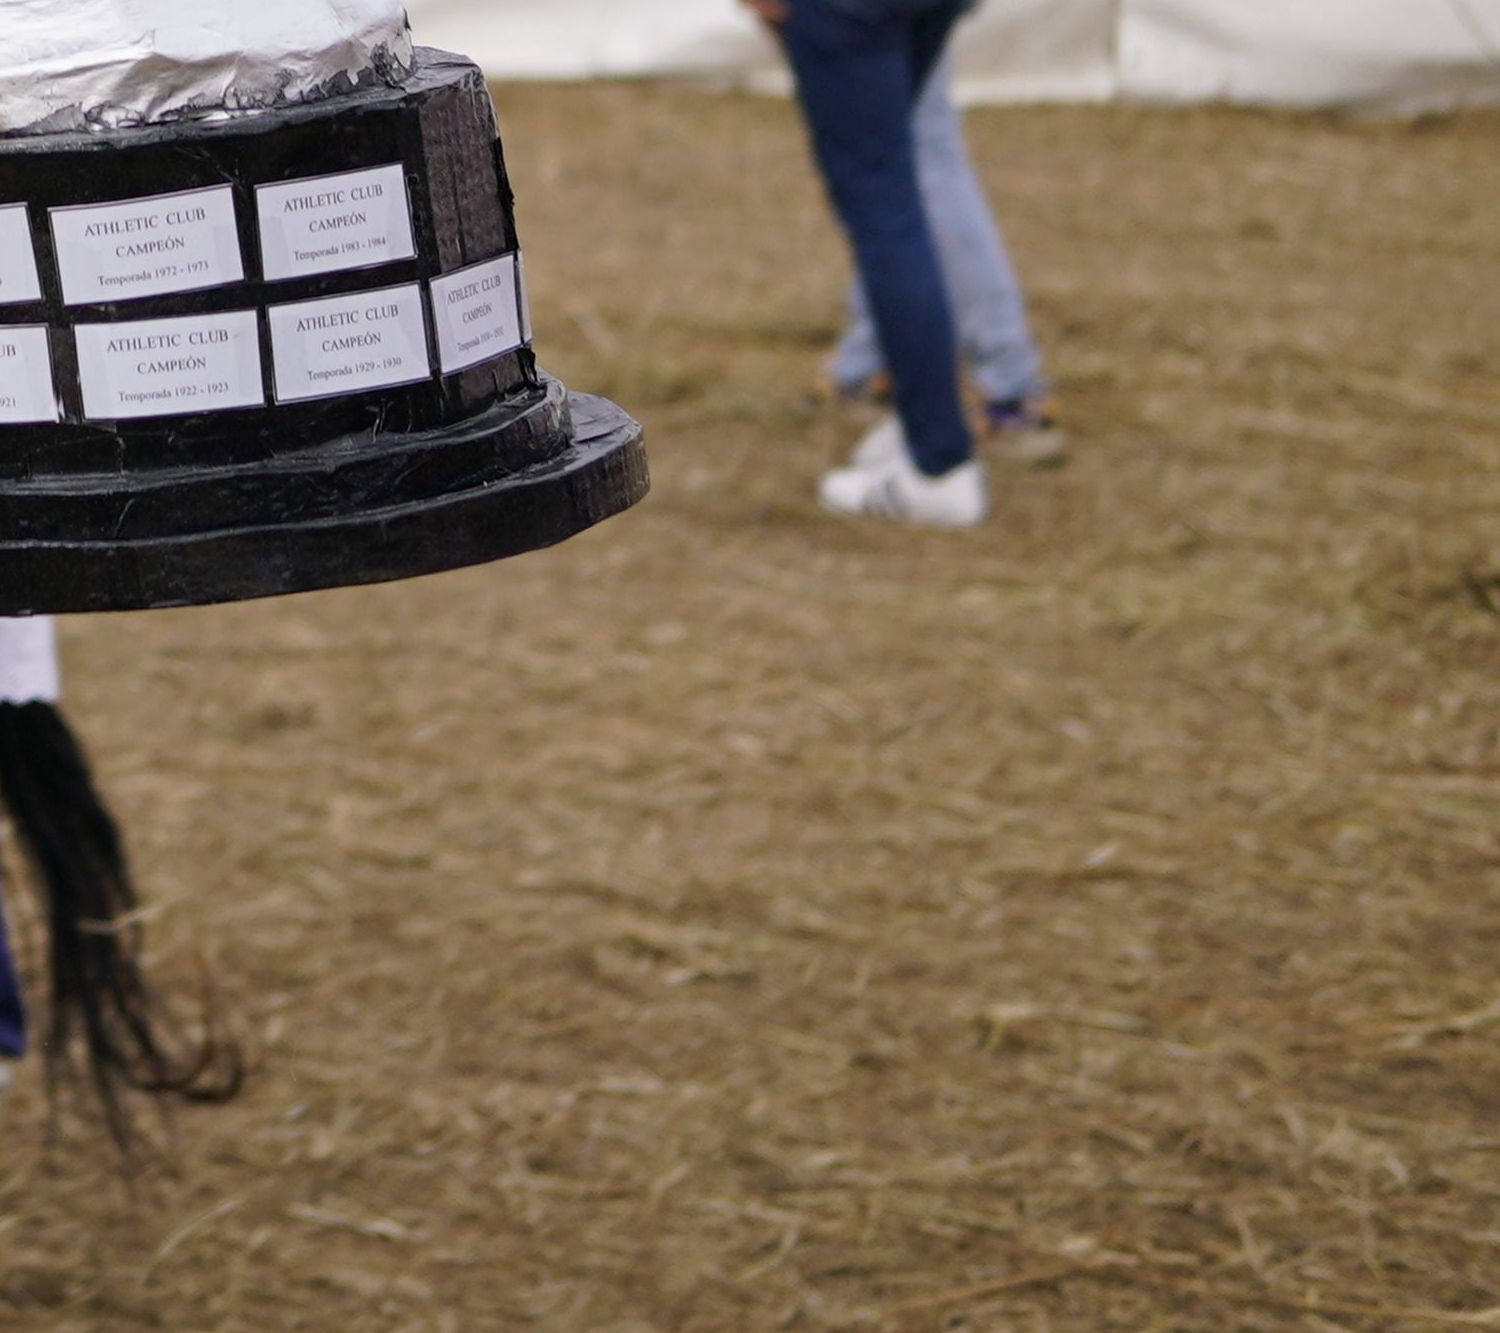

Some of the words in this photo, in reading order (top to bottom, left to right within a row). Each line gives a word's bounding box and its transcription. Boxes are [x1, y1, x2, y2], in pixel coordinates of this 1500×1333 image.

[284, 191, 345, 212] ATHLETIC
[351, 184, 383, 201] CLUB
[85, 215, 158, 237] ATHLETIC
[166, 209, 205, 226] CLUB
[309, 211, 366, 233] CAMPEÓN
[116, 236, 185, 258] CAMPEÓN
[293, 245, 339, 261] Temporada
[98, 270, 152, 286] Temporada
[447, 282, 479, 305] ATHLETIC
[481, 275, 501, 291] CLUB
[297, 311, 359, 332] ATHLETIC
[365, 304, 398, 321] CLUB
[107, 335, 181, 352] ATHLETIC
[189, 330, 228, 345] CLUB
[322, 332, 381, 352] CAMPEÓN
[137, 355, 206, 374] CAMPEÓN
[307, 365, 352, 382] Temporada
[118, 389, 172, 403] Temporada
